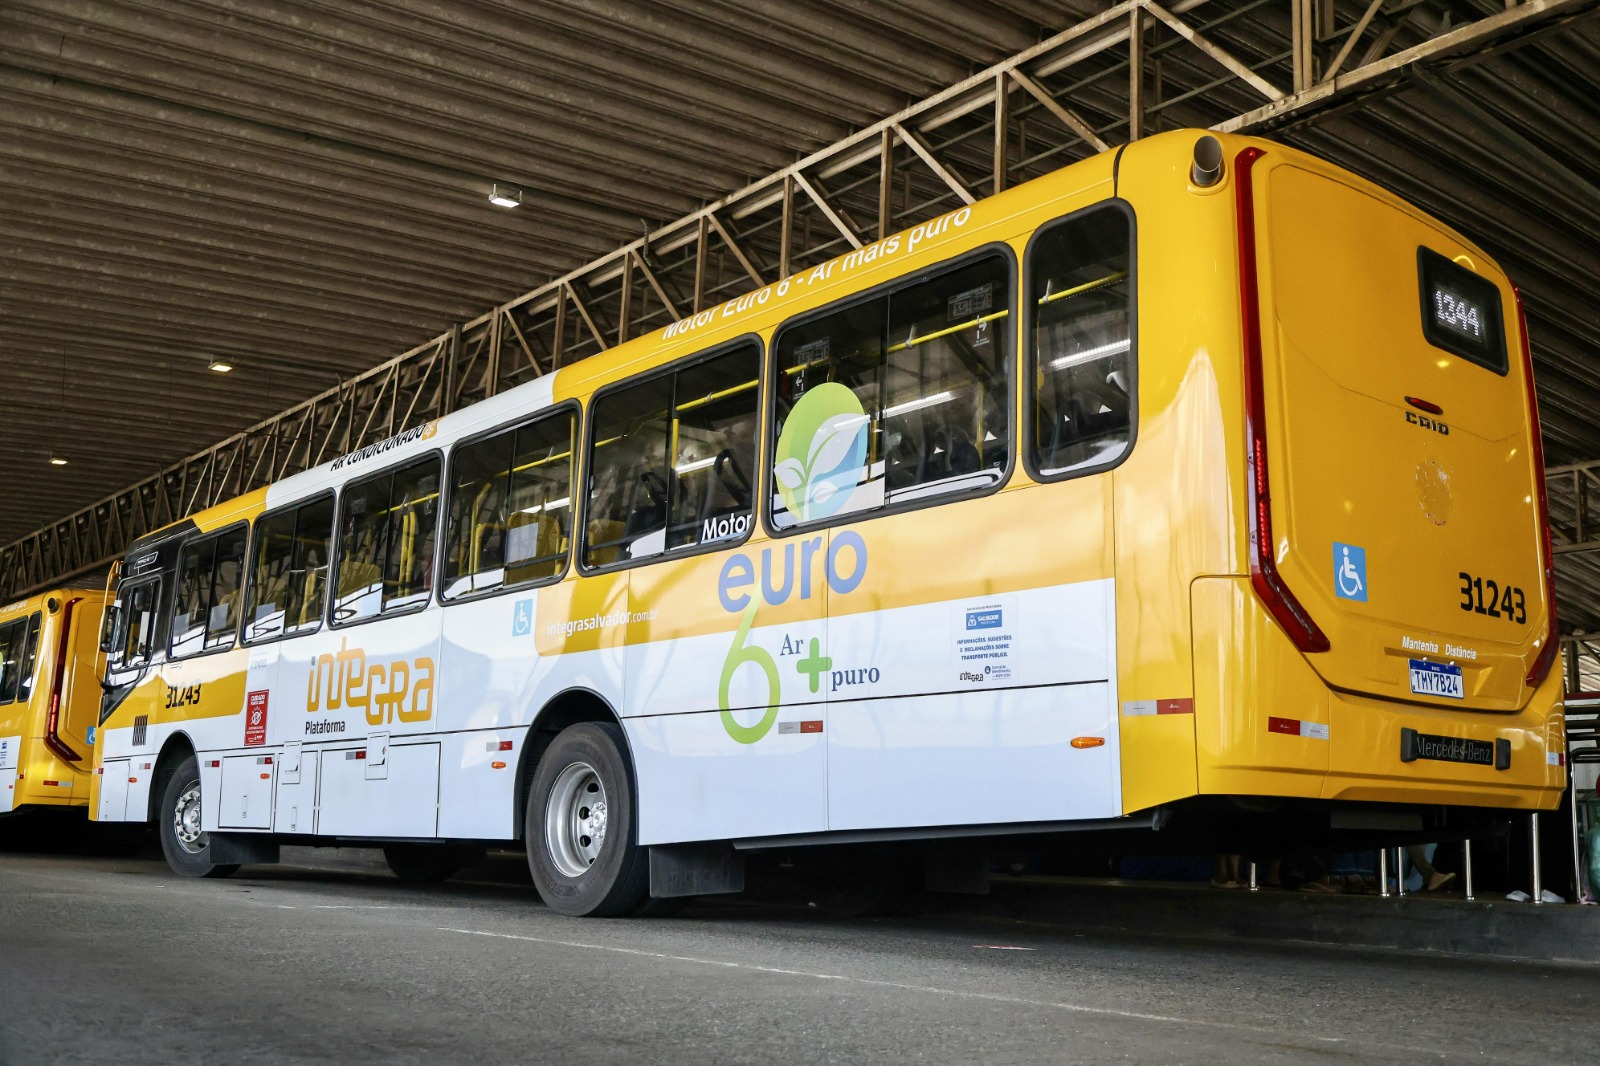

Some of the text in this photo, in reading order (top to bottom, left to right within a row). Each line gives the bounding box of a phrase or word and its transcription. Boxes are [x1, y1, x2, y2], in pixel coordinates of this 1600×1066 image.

[662, 306, 720, 340] Motor
[722, 287, 771, 318] Euro
[777, 275, 793, 297] 6
[808, 262, 836, 286] Ar
[841, 235, 901, 272] mais
[907, 207, 972, 252] puro
[1435, 290, 1480, 336] 1344
[1405, 410, 1449, 436] CAIO
[330, 422, 428, 472] AR CONDICIONADO
[701, 512, 752, 541] Motor
[718, 530, 868, 613] euro
[1458, 572, 1527, 625] 31243
[547, 607, 658, 637] integrasalvador.com.br
[718, 575, 781, 745] 6
[780, 633, 804, 656] Ar
[831, 666, 880, 692] puro
[1402, 636, 1477, 660] Mantenha Distância
[165, 679, 202, 709] 31243
[1415, 671, 1458, 694] TMY7B24
[305, 719, 345, 735] Plataforma
[1416, 736, 1492, 763] Mercedes-Benz
